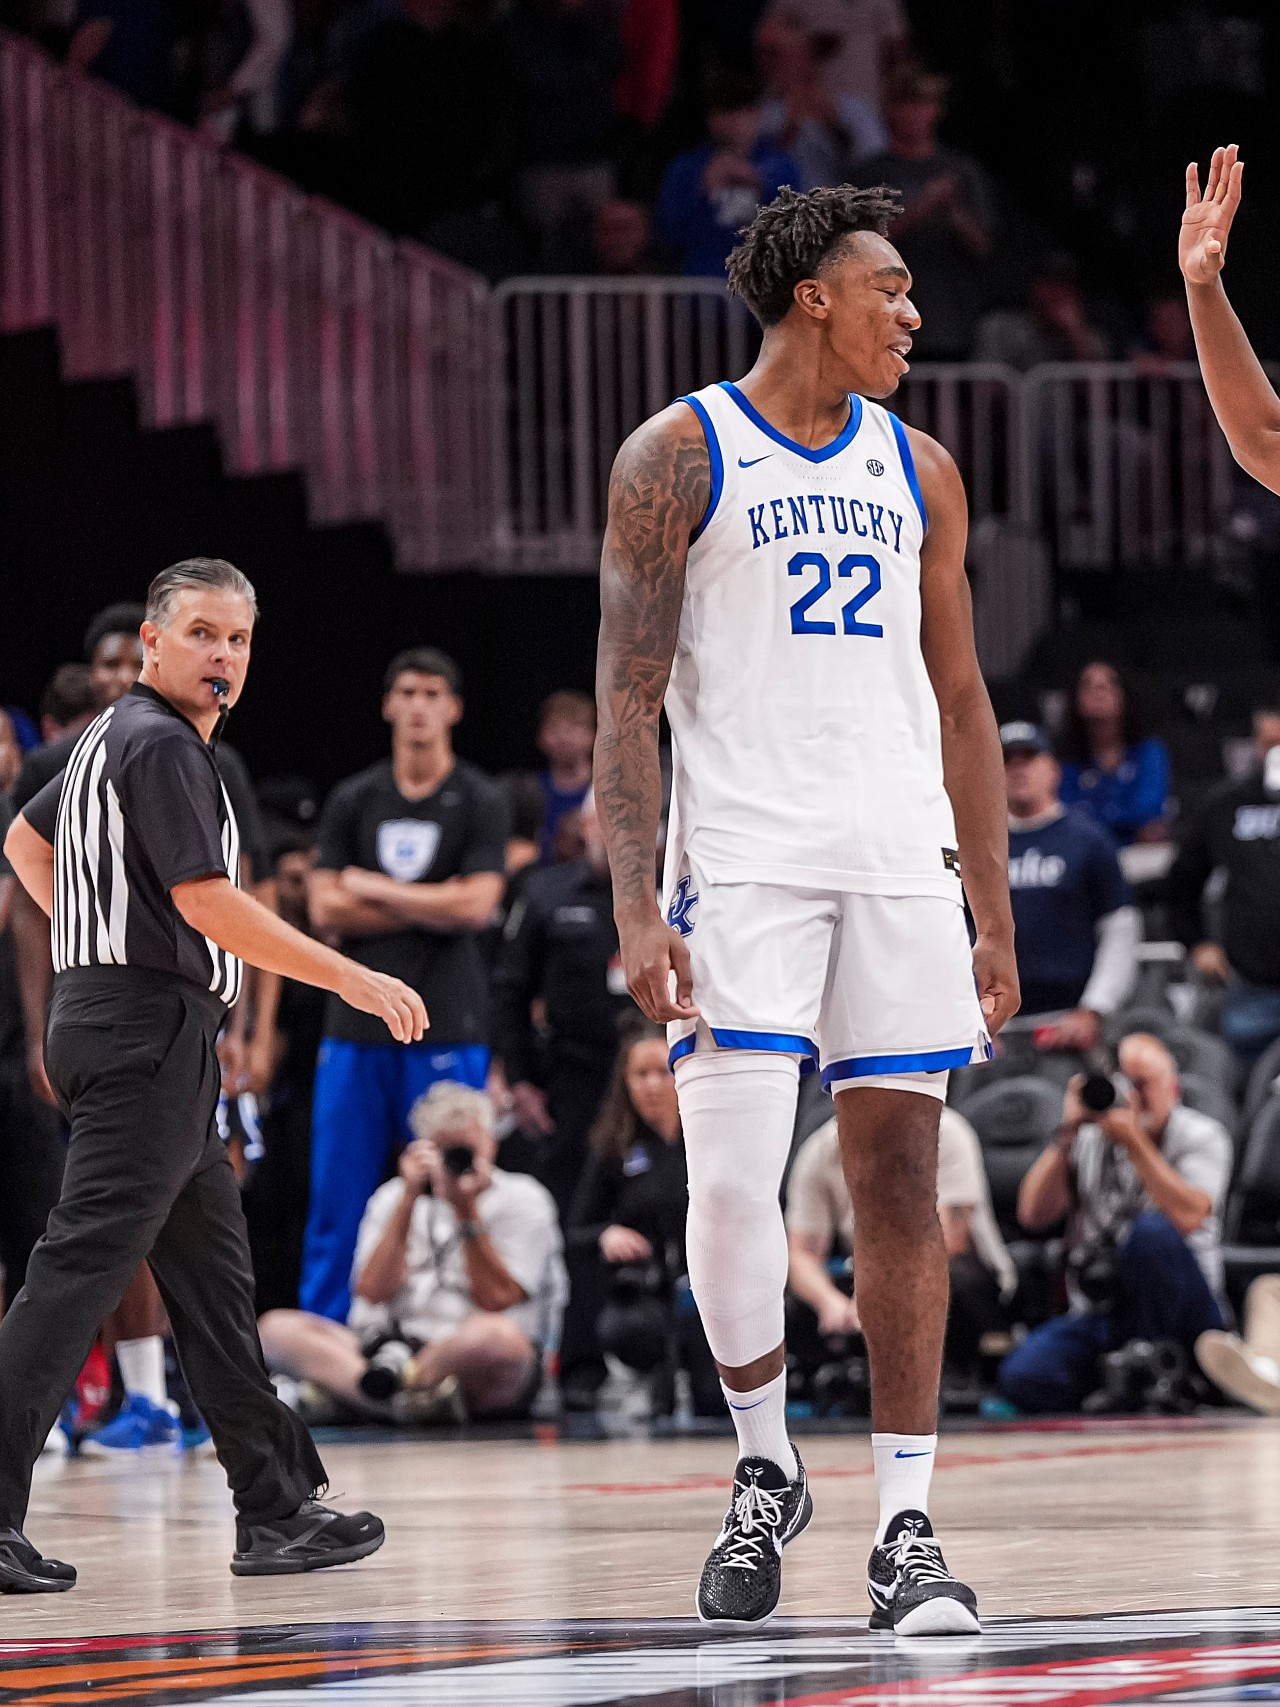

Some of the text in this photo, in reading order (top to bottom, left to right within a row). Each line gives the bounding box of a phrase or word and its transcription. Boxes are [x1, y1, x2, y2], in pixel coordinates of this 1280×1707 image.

[866, 459, 885, 476] SEC
[747, 494, 903, 554] KENTUCKY
[787, 552, 883, 638] 22
